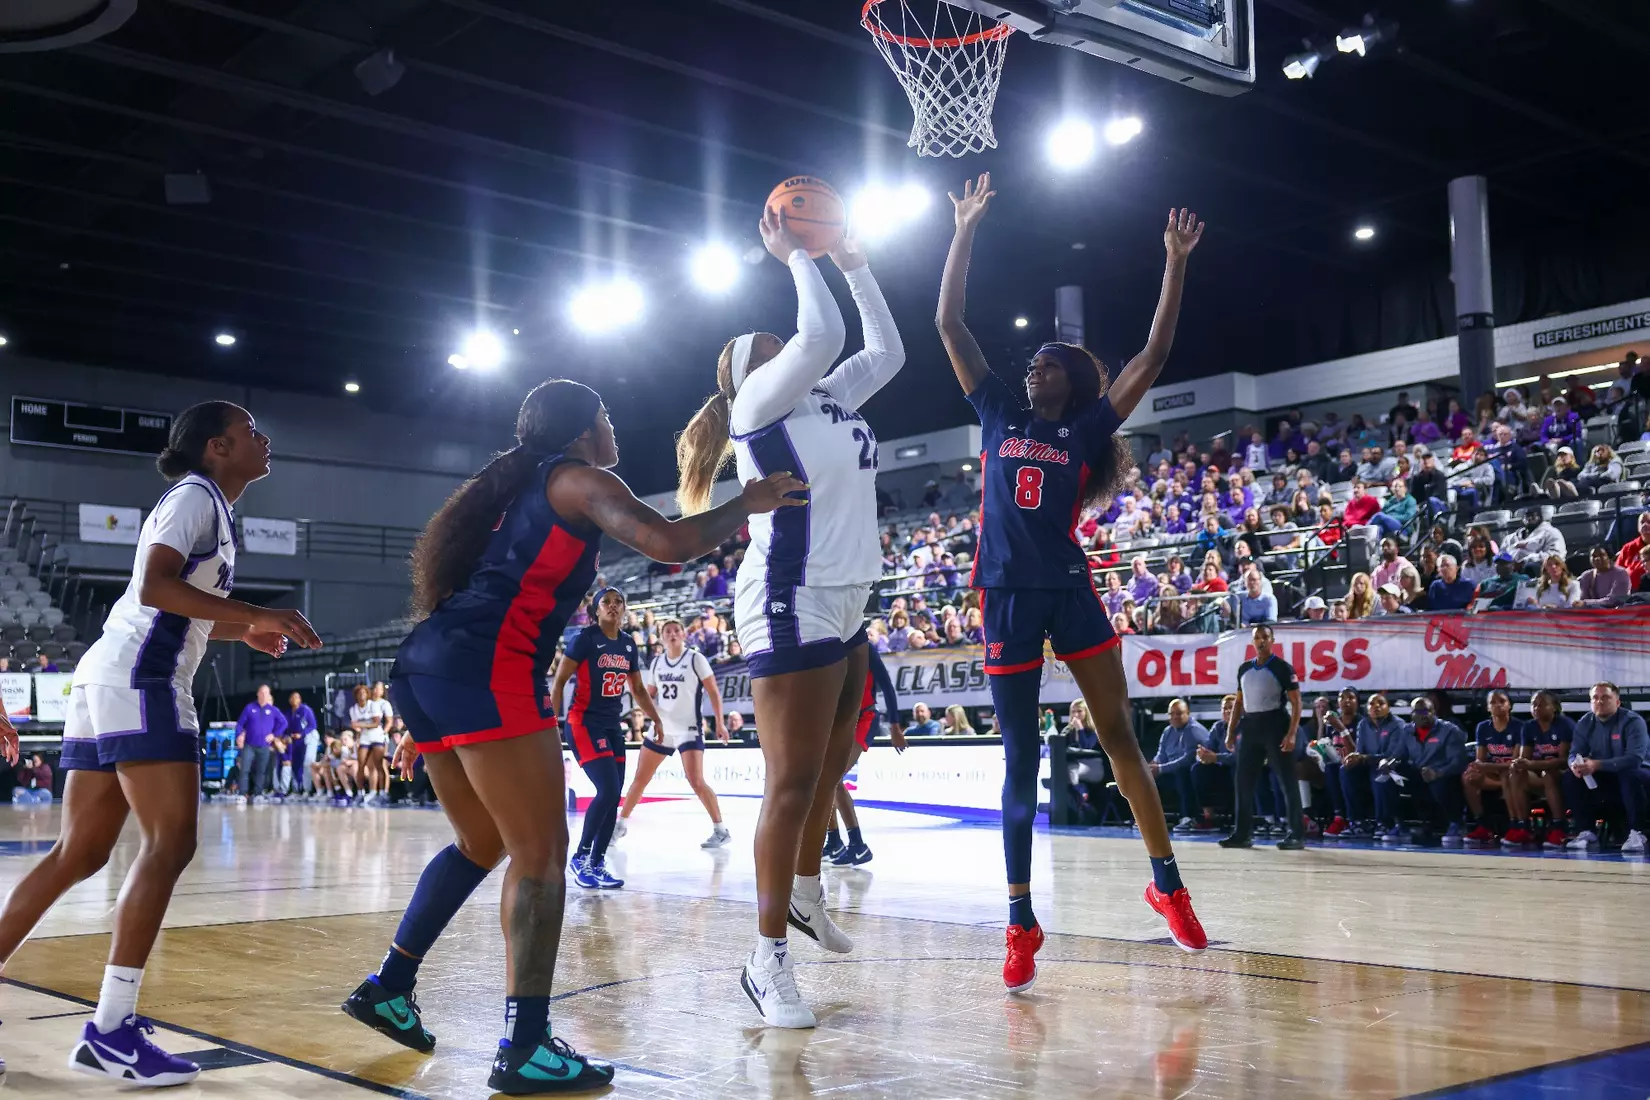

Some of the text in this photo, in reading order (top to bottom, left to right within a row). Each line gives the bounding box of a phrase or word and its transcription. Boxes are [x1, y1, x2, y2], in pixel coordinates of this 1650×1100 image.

[1536, 313, 1650, 346] REFRESHMENTS
[21, 403, 48, 416] HOME
[138, 416, 166, 429] GUEST
[1057, 427, 1070, 438] SEC
[999, 437, 1070, 465] Ole Miss
[1014, 465, 1045, 509] 8
[1424, 614, 1470, 652] Ole
[1137, 638, 1372, 687] OLE ISS
[1435, 653, 1511, 688] Miss
[602, 671, 627, 697] 22
[658, 673, 685, 682] Wildcats
[662, 684, 678, 699] 23
